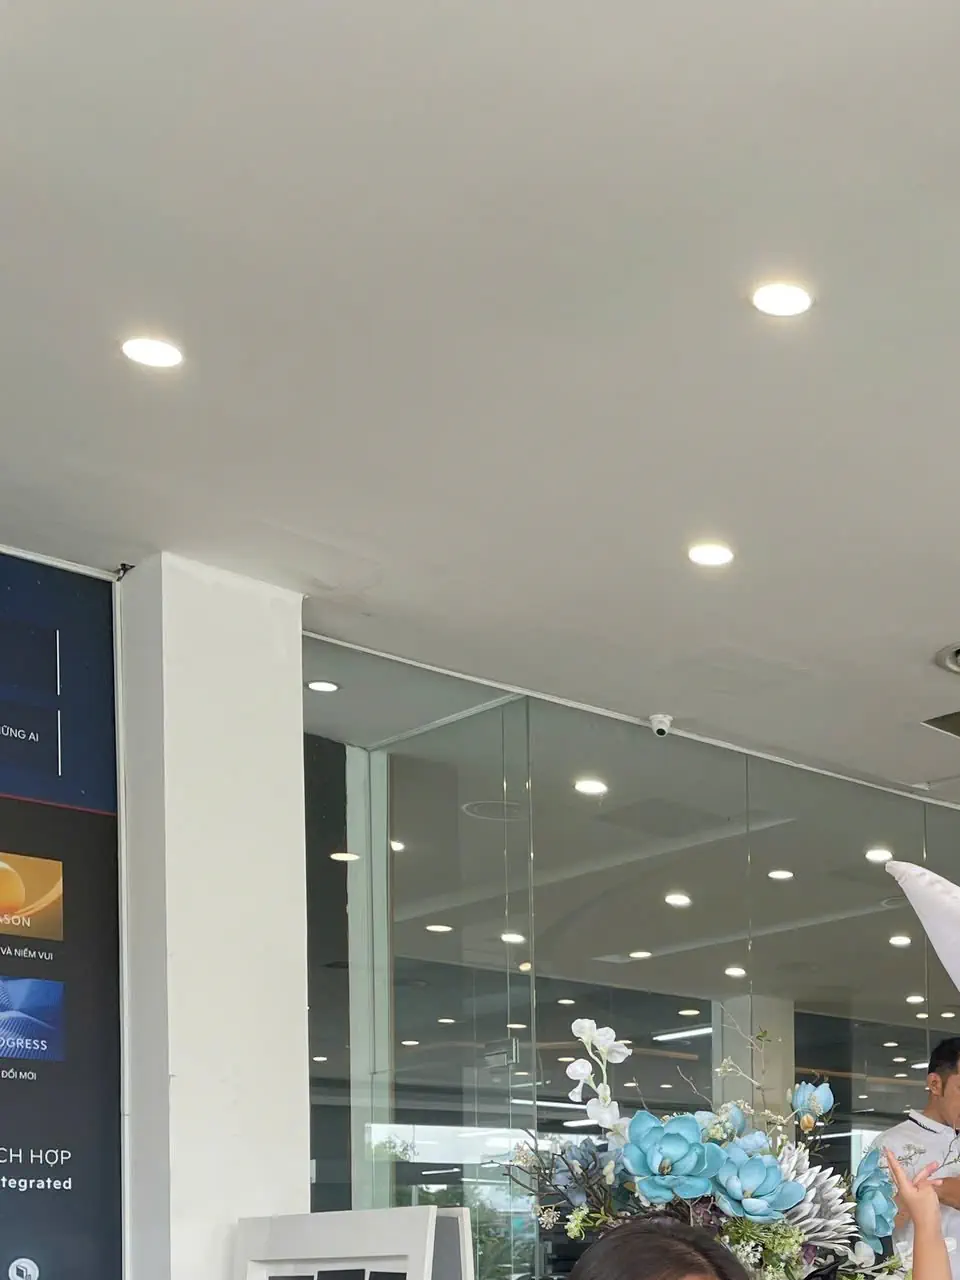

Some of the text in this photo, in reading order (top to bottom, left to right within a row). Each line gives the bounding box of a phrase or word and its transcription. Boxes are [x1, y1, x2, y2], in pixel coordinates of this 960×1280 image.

[0, 724, 39, 742] ỮNG AI
[0, 914, 30, 927] SON
[38, 951, 53, 961] VUI
[30, 1149, 71, 1167] HỢP
[0, 1176, 72, 1192] tegrated
